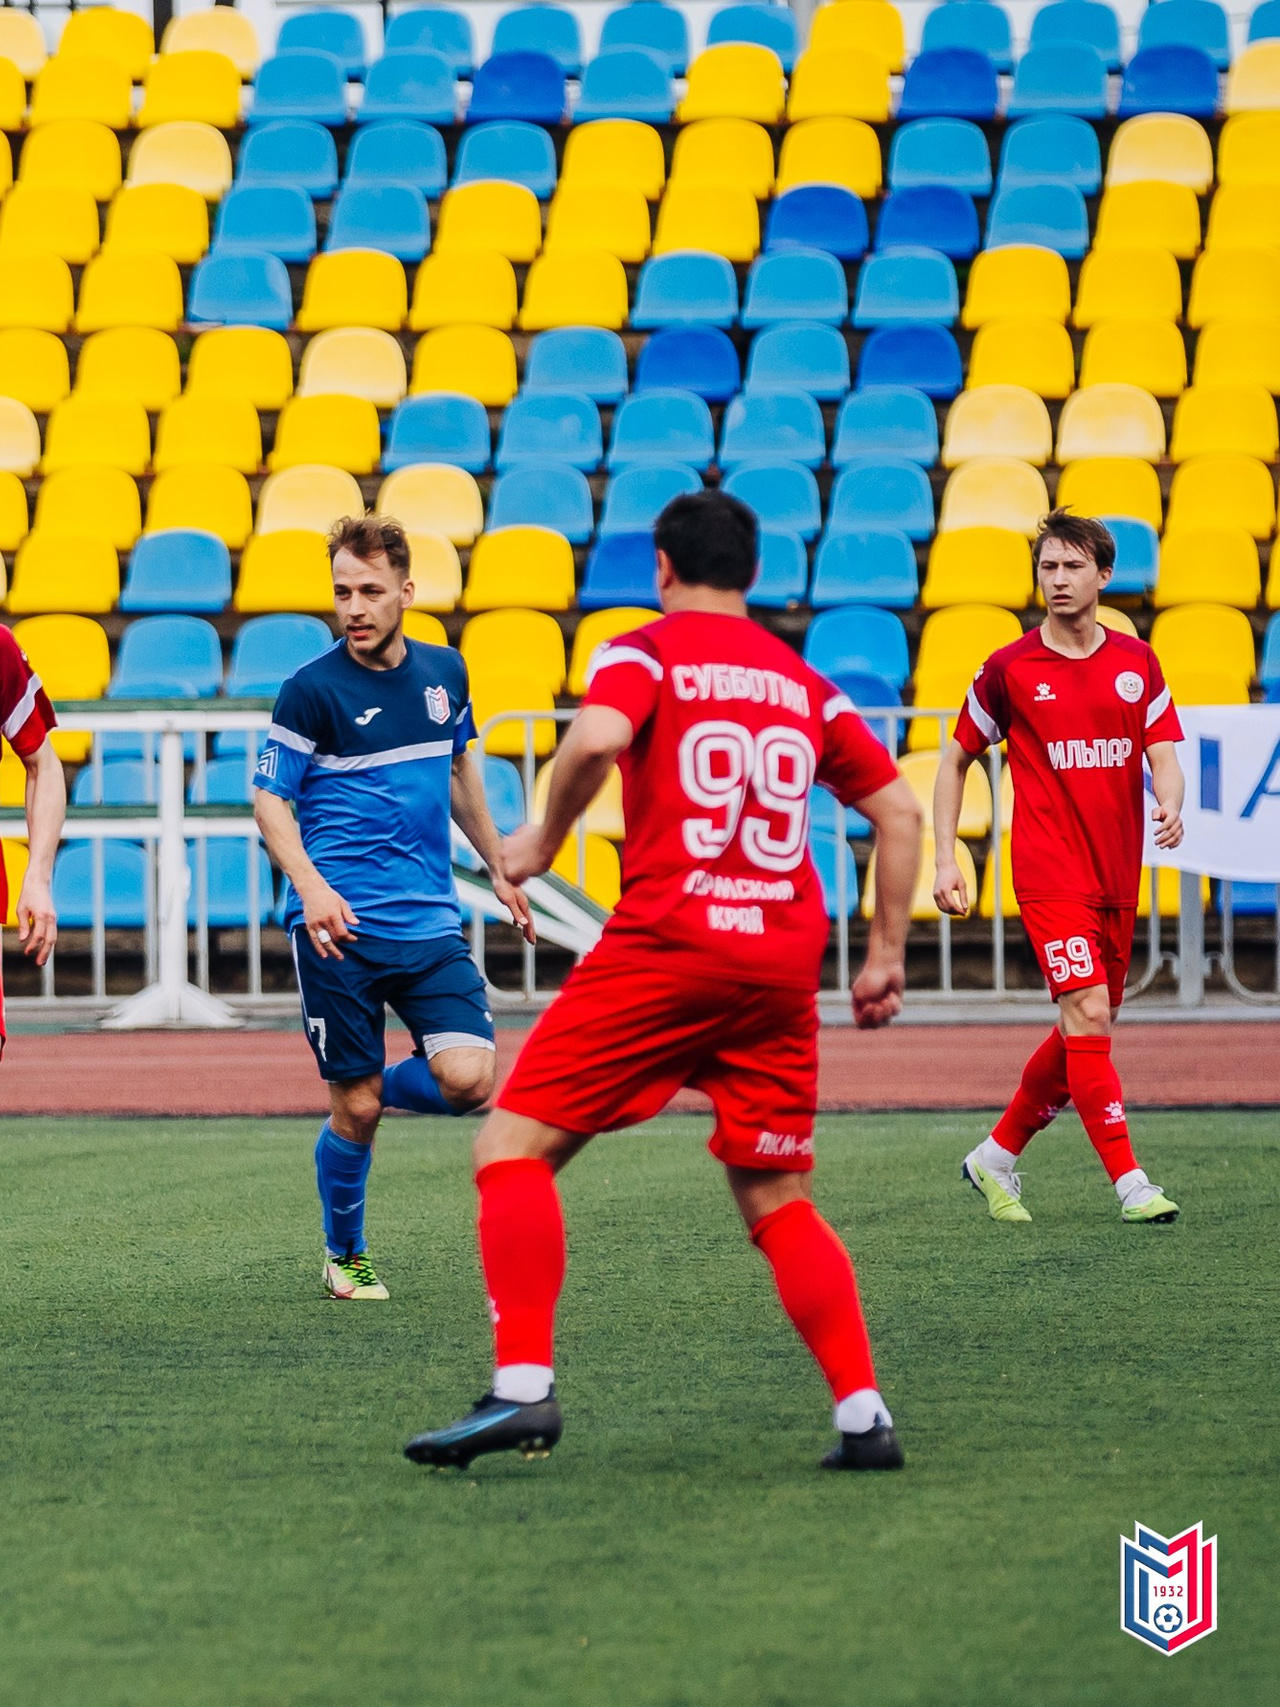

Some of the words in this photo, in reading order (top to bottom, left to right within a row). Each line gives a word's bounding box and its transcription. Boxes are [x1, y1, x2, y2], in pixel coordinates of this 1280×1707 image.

[671, 662, 811, 719] СУББОТИН
[1046, 737, 1133, 770] ИЛЬПАР
[678, 720, 817, 873] 99
[1043, 936, 1094, 984] 59
[308, 1016, 327, 1062] 7
